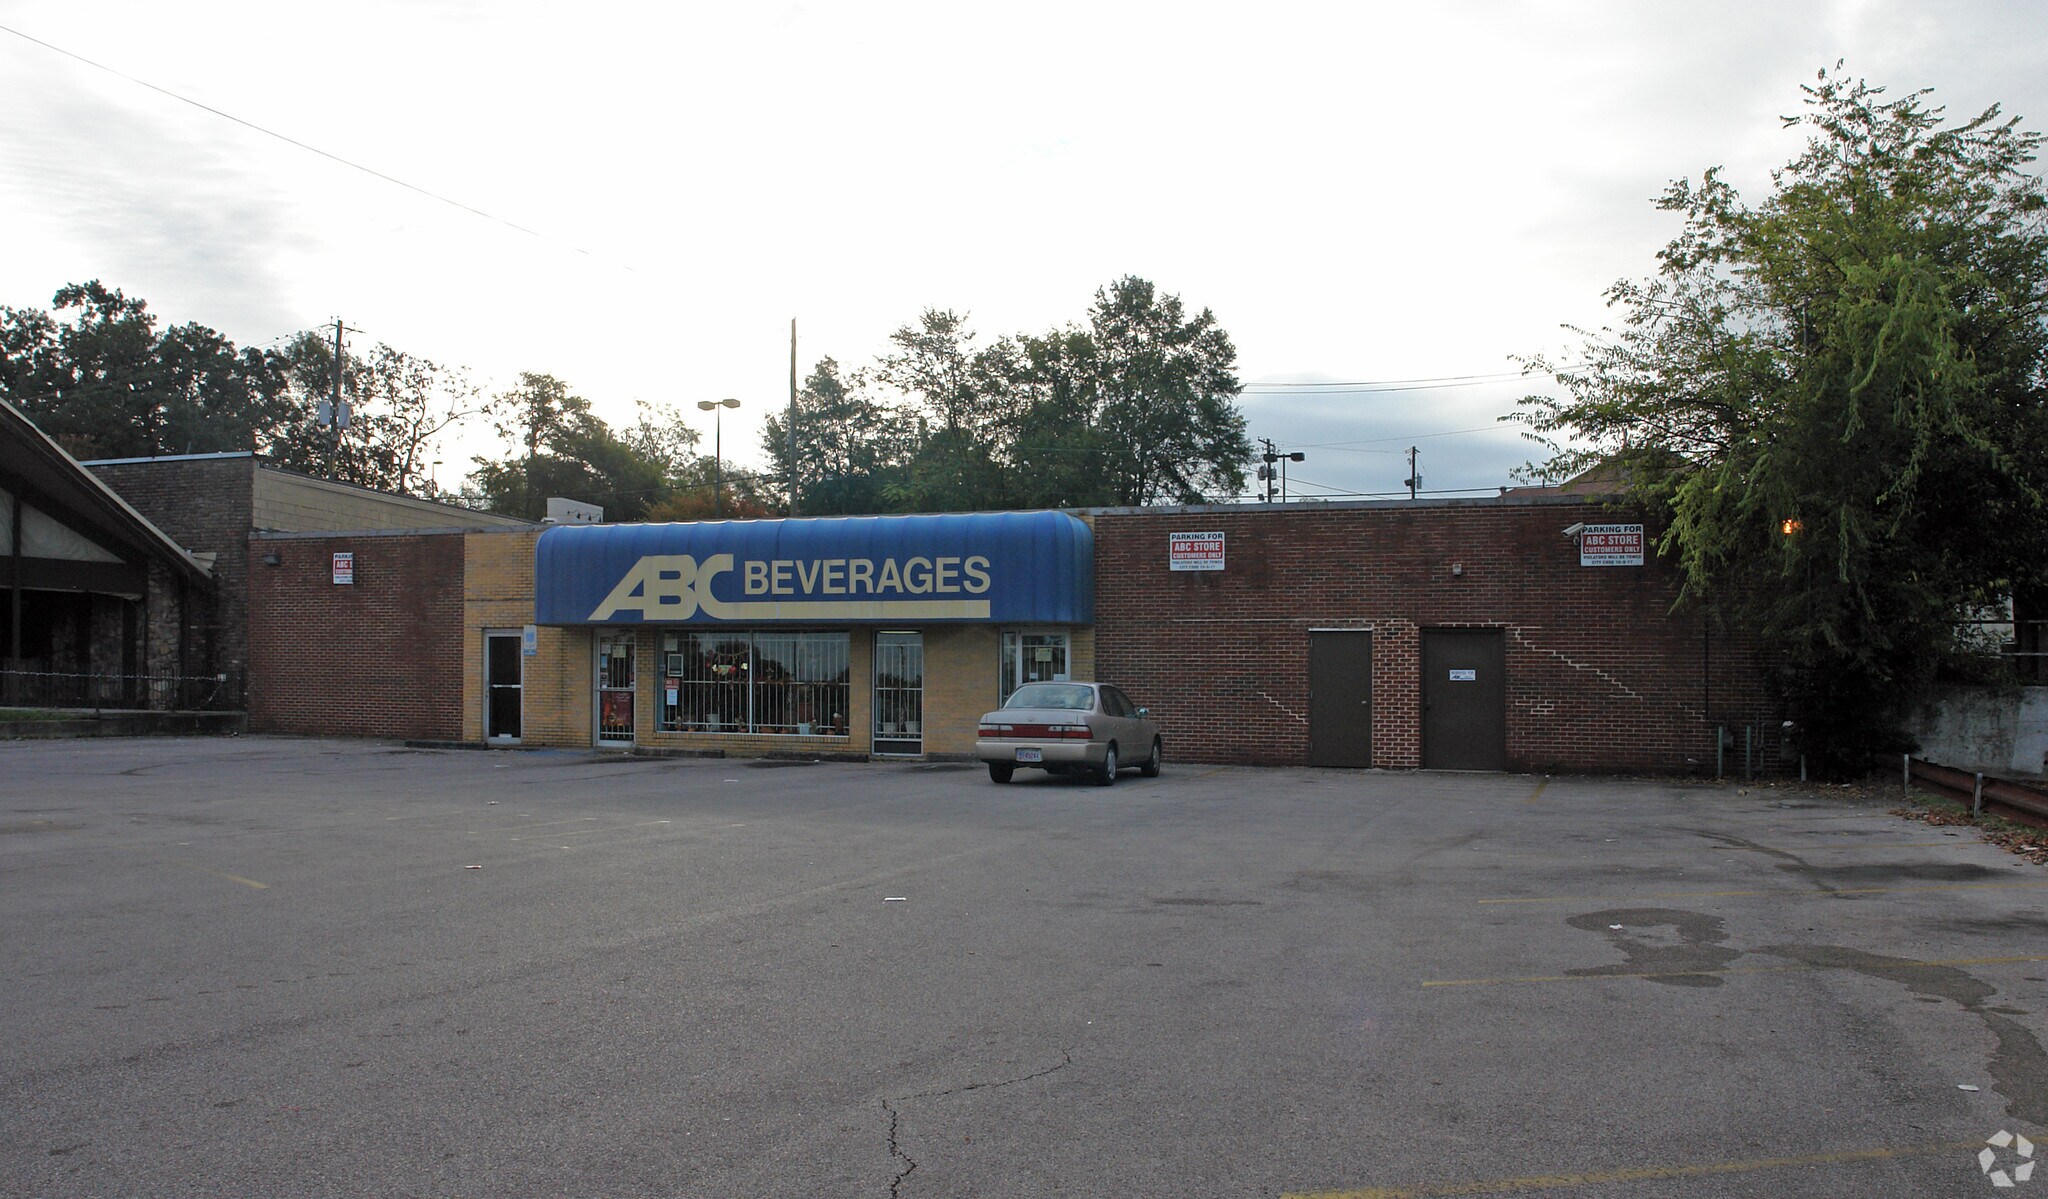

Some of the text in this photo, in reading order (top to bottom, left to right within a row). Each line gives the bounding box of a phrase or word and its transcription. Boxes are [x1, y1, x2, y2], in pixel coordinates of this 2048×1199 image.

[1586, 536, 1638, 545] ABC STORE
[1175, 542, 1220, 551] ABC STORE
[588, 554, 991, 620] ABC BEVERAGES
